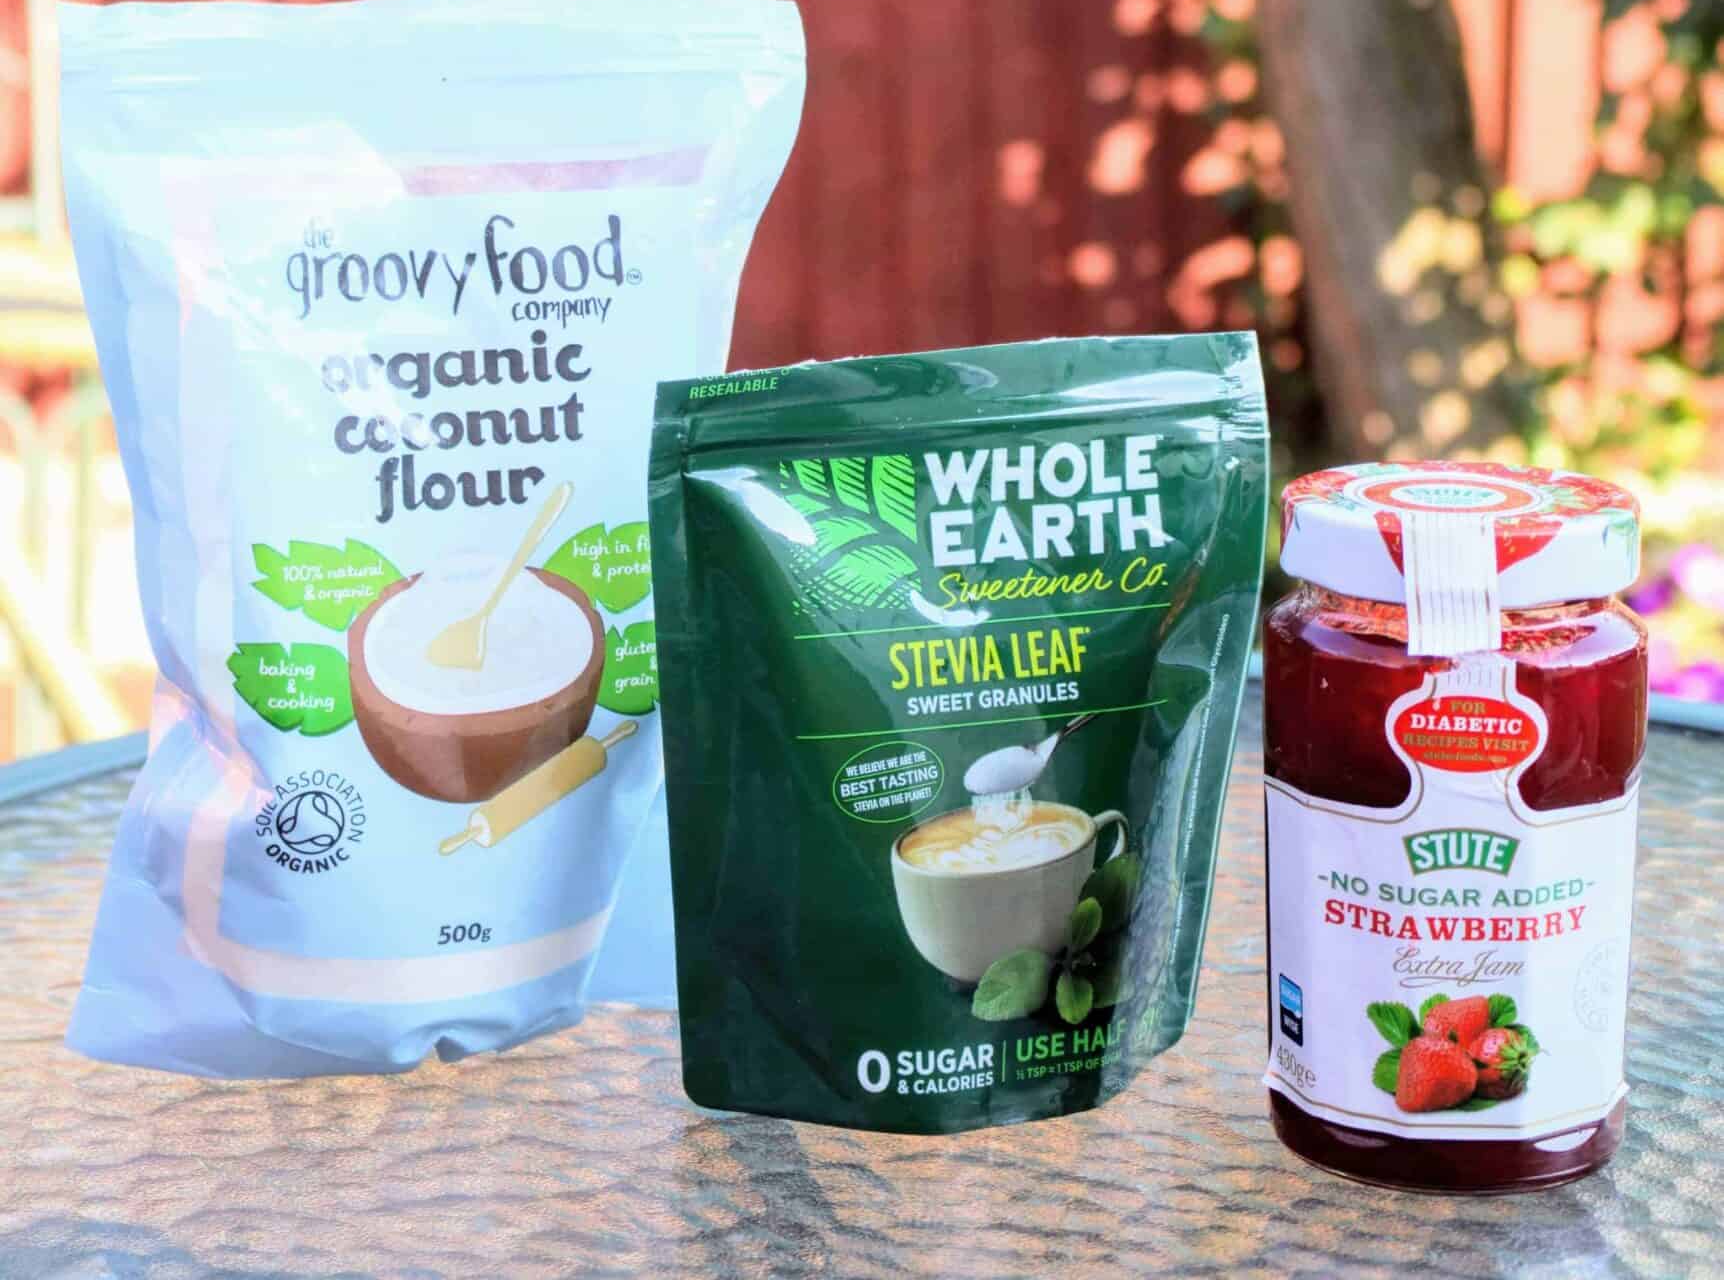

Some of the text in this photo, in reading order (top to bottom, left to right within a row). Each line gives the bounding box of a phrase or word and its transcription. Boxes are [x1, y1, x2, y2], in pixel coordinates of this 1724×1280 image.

[286, 249, 477, 320] groovy
[485, 214, 624, 295] food
[512, 296, 612, 329] company
[321, 329, 592, 399] organic
[689, 376, 779, 399] RESEALABLE
[334, 392, 584, 455] coconut
[923, 433, 1164, 506] WHOLE
[375, 454, 545, 524] flour
[929, 493, 1168, 568] EARTH
[573, 539, 609, 560] high
[615, 540, 632, 554] in
[282, 560, 384, 583] 100% natural
[592, 561, 601, 577] &
[938, 557, 1169, 611] Sweetener Co.
[303, 584, 375, 604] & organic
[258, 657, 315, 680] baking
[888, 634, 1005, 691] STEVIA
[287, 679, 297, 694] &
[907, 681, 1080, 717] SWEET GRANULES
[267, 695, 335, 713] cooking
[1450, 701, 1486, 715] FOR
[1410, 713, 1523, 735] DIABETIC
[1403, 733, 1530, 752] RECIPES VISIT
[845, 751, 927, 778] WE BELIEVE WE ARE THE
[840, 766, 939, 799] BEST TASTING
[256, 769, 367, 843] SOIL ASSOCIATION
[853, 799, 878, 814] STEVIA
[879, 796, 891, 808] ON
[891, 794, 905, 806] THE
[265, 843, 350, 875] ORGANIC
[1412, 830, 1509, 871] STUTE
[1378, 883, 1480, 907] SUGAR
[437, 922, 493, 945] 500g
[1324, 898, 1587, 942] STRAWBERRY
[1393, 945, 1525, 988] Extra Jam
[1016, 1033, 1066, 1062] USE
[1072, 1018, 1127, 1054] HALF
[857, 1049, 891, 1093] 0
[897, 1043, 995, 1076] SUGAR
[1027, 1065, 1047, 1079] TSP
[1064, 1061, 1083, 1073] TSP
[897, 1071, 994, 1095] & CALORIES
